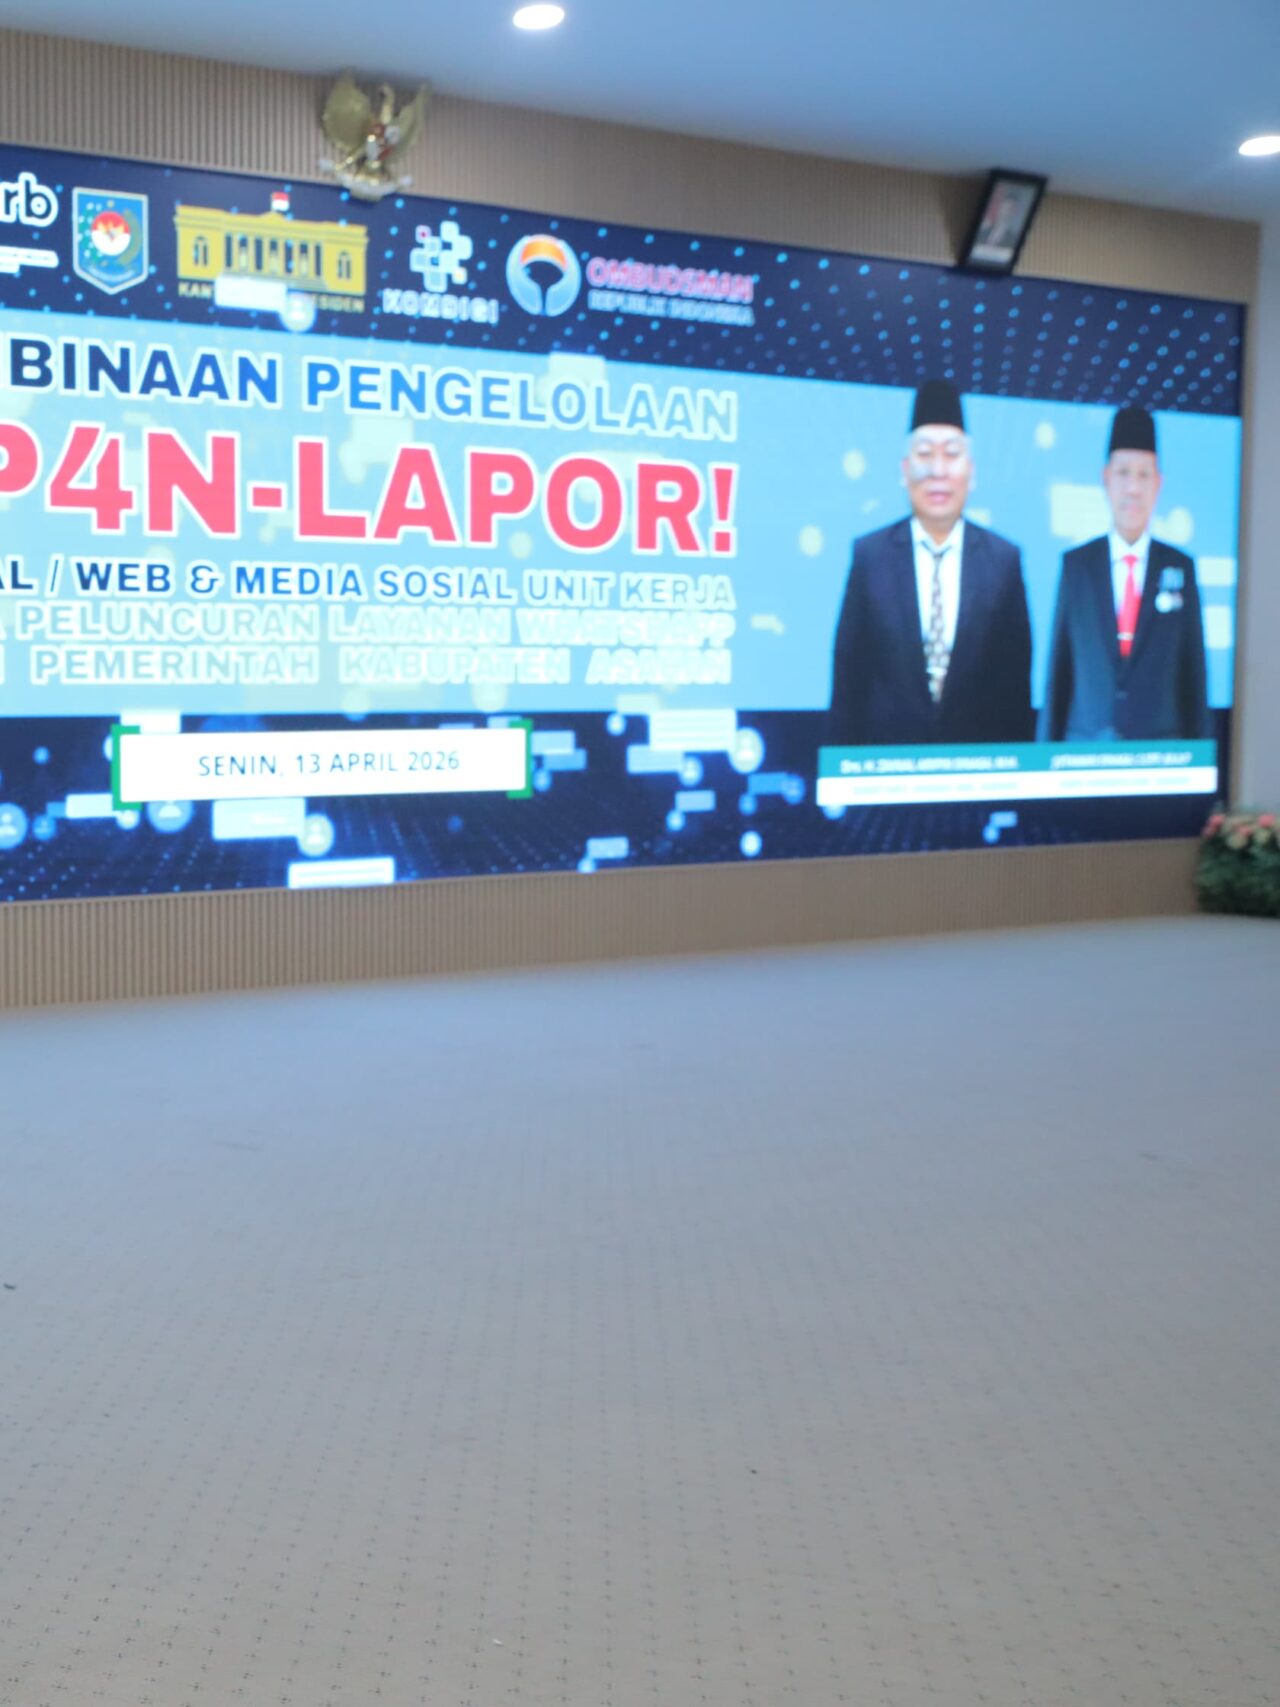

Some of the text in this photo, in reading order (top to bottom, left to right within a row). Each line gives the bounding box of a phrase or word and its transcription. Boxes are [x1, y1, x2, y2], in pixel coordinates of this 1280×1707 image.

[307, 361, 736, 440] PENGELOLAAN
[76, 562, 171, 592] WEB
[191, 565, 219, 593] &
[236, 567, 362, 597] MEDIA
[379, 570, 513, 600] SOSIAL
[528, 575, 611, 603] UNIT
[626, 576, 732, 605] KERJA
[20, 605, 318, 639] PELUNCURAN
[330, 608, 510, 641] LAYANAN
[35, 649, 318, 682] PEMERINTAH
[341, 648, 570, 683] KABUPATEN
[296, 753, 320, 775] 13
[329, 752, 399, 773] APRIL
[407, 750, 461, 771] 2026
